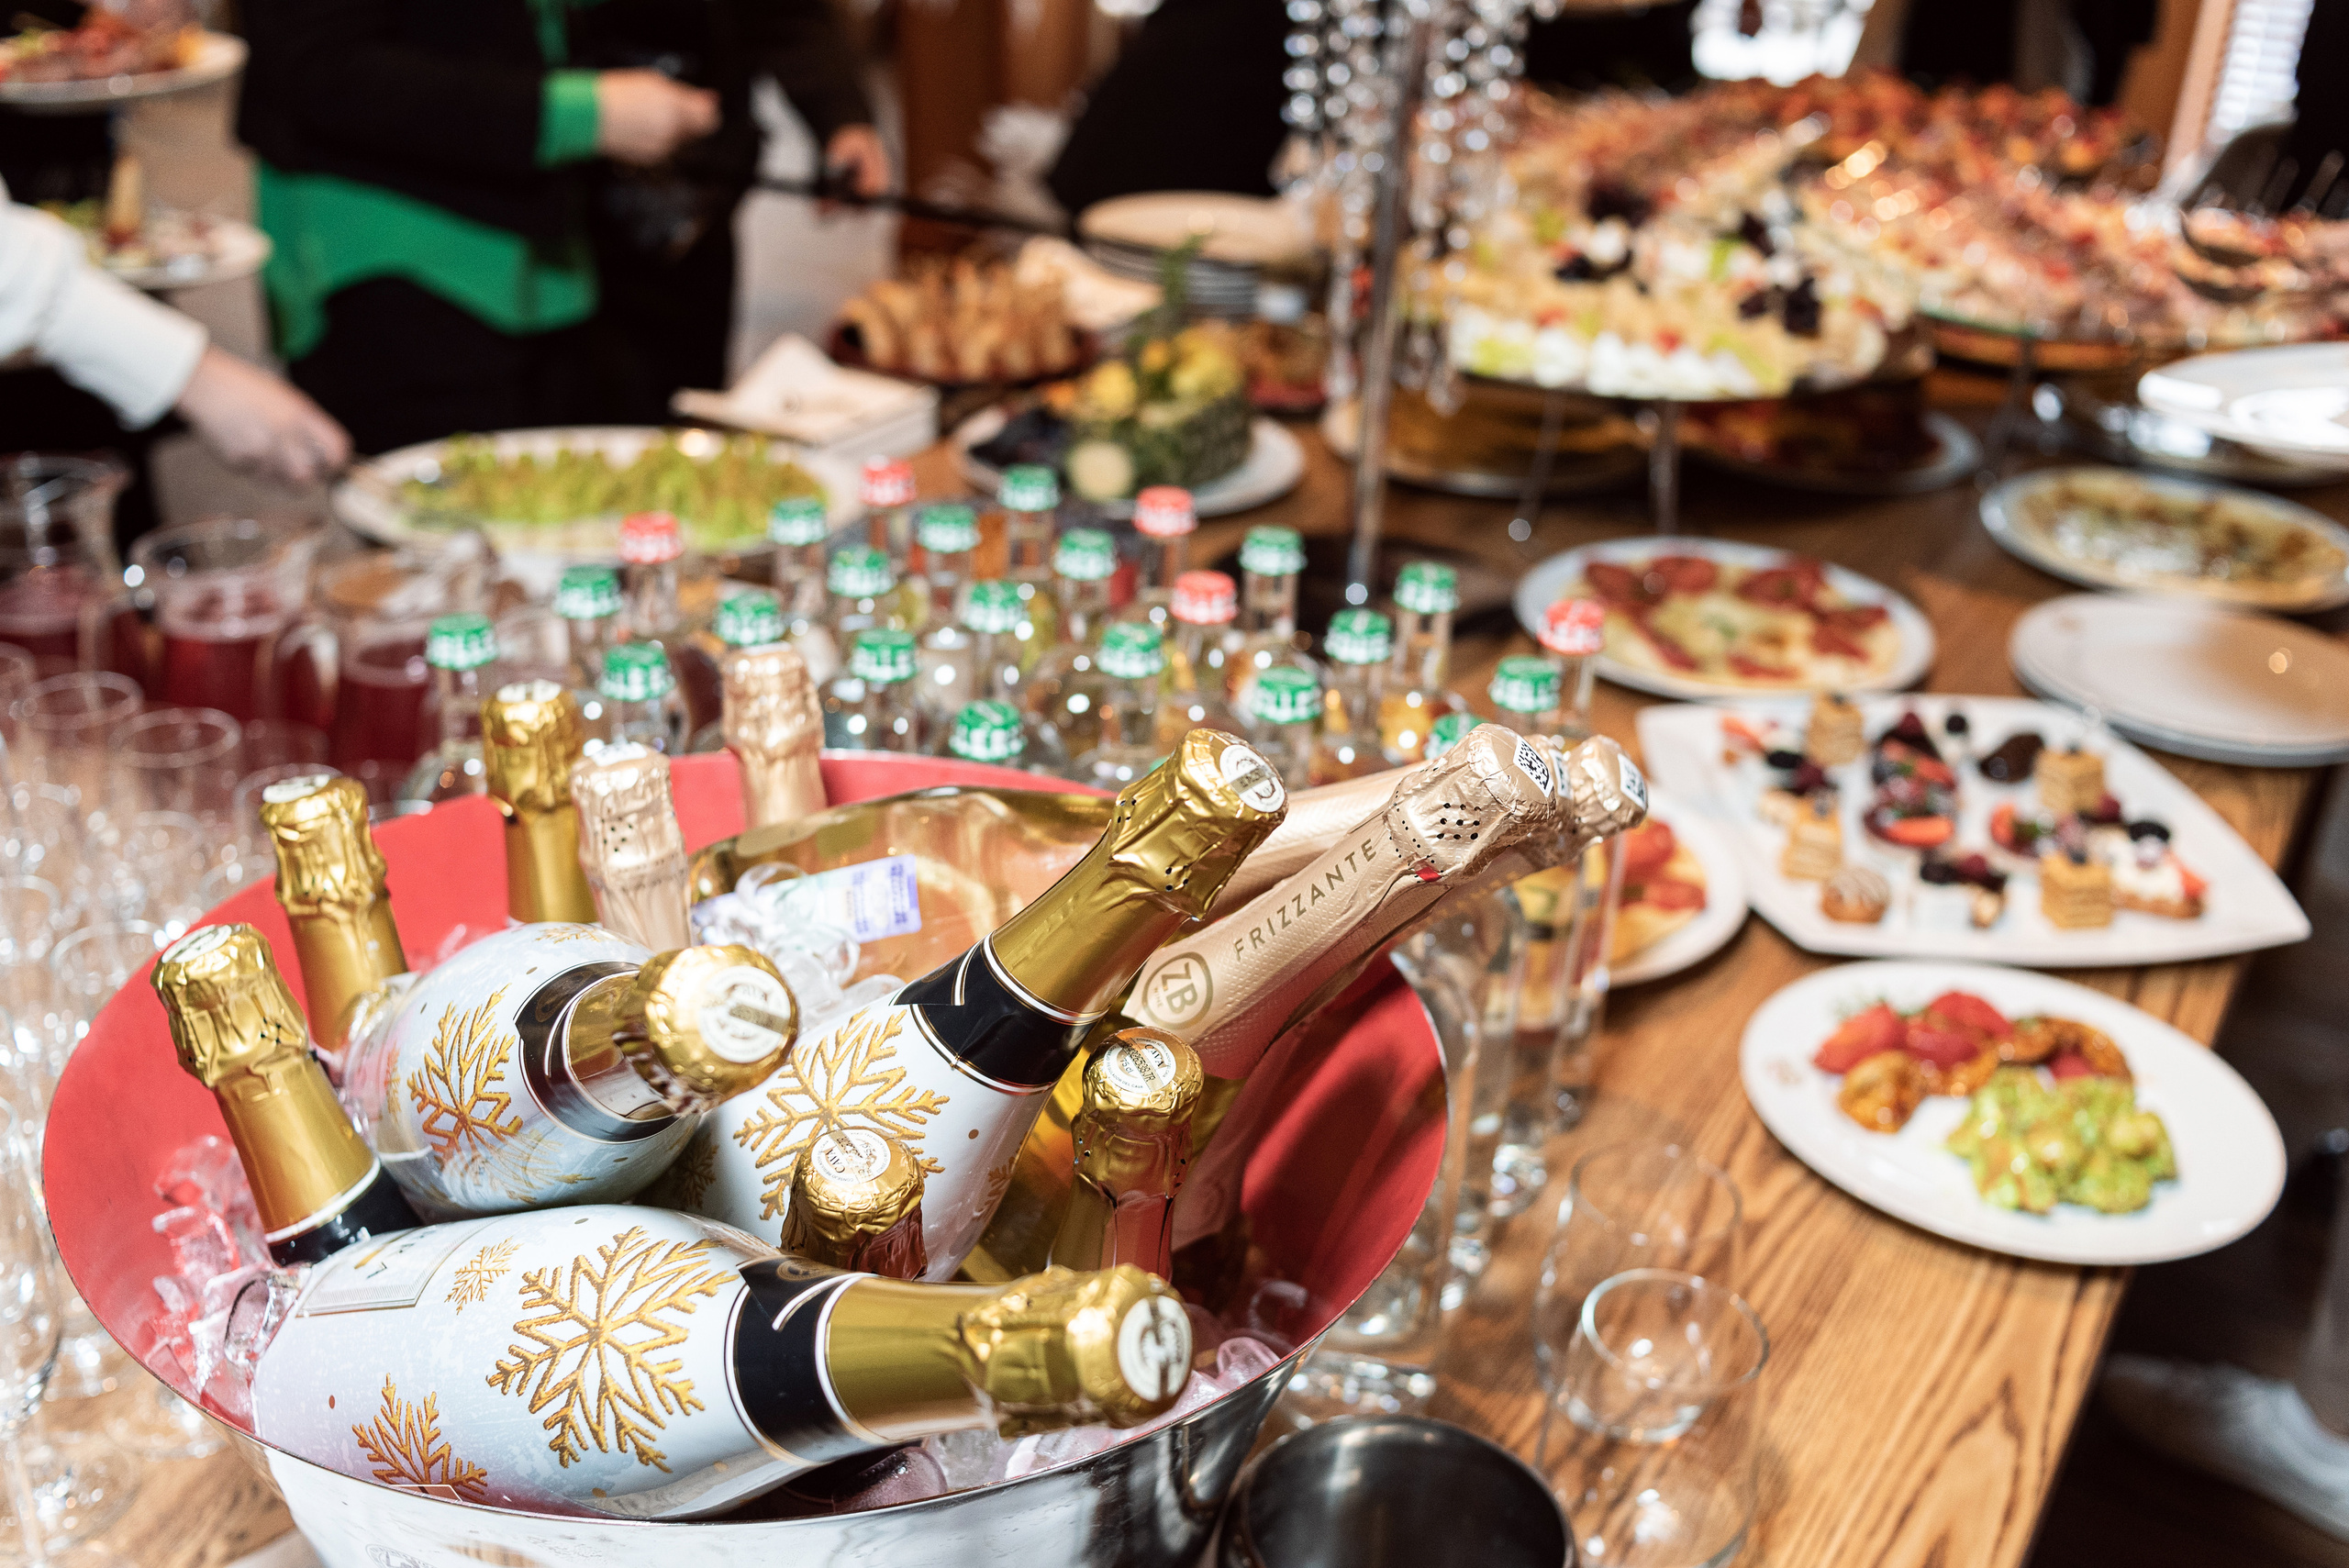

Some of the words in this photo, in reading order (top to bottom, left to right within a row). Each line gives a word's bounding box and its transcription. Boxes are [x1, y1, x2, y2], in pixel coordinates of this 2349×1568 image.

[1233, 838, 1376, 962] FRIZZANTE
[1162, 962, 1197, 1014] ZB
[1119, 1058, 1130, 1068] 75
[1144, 1044, 1164, 1067] CAVA
[825, 1149, 846, 1173] CAVA
